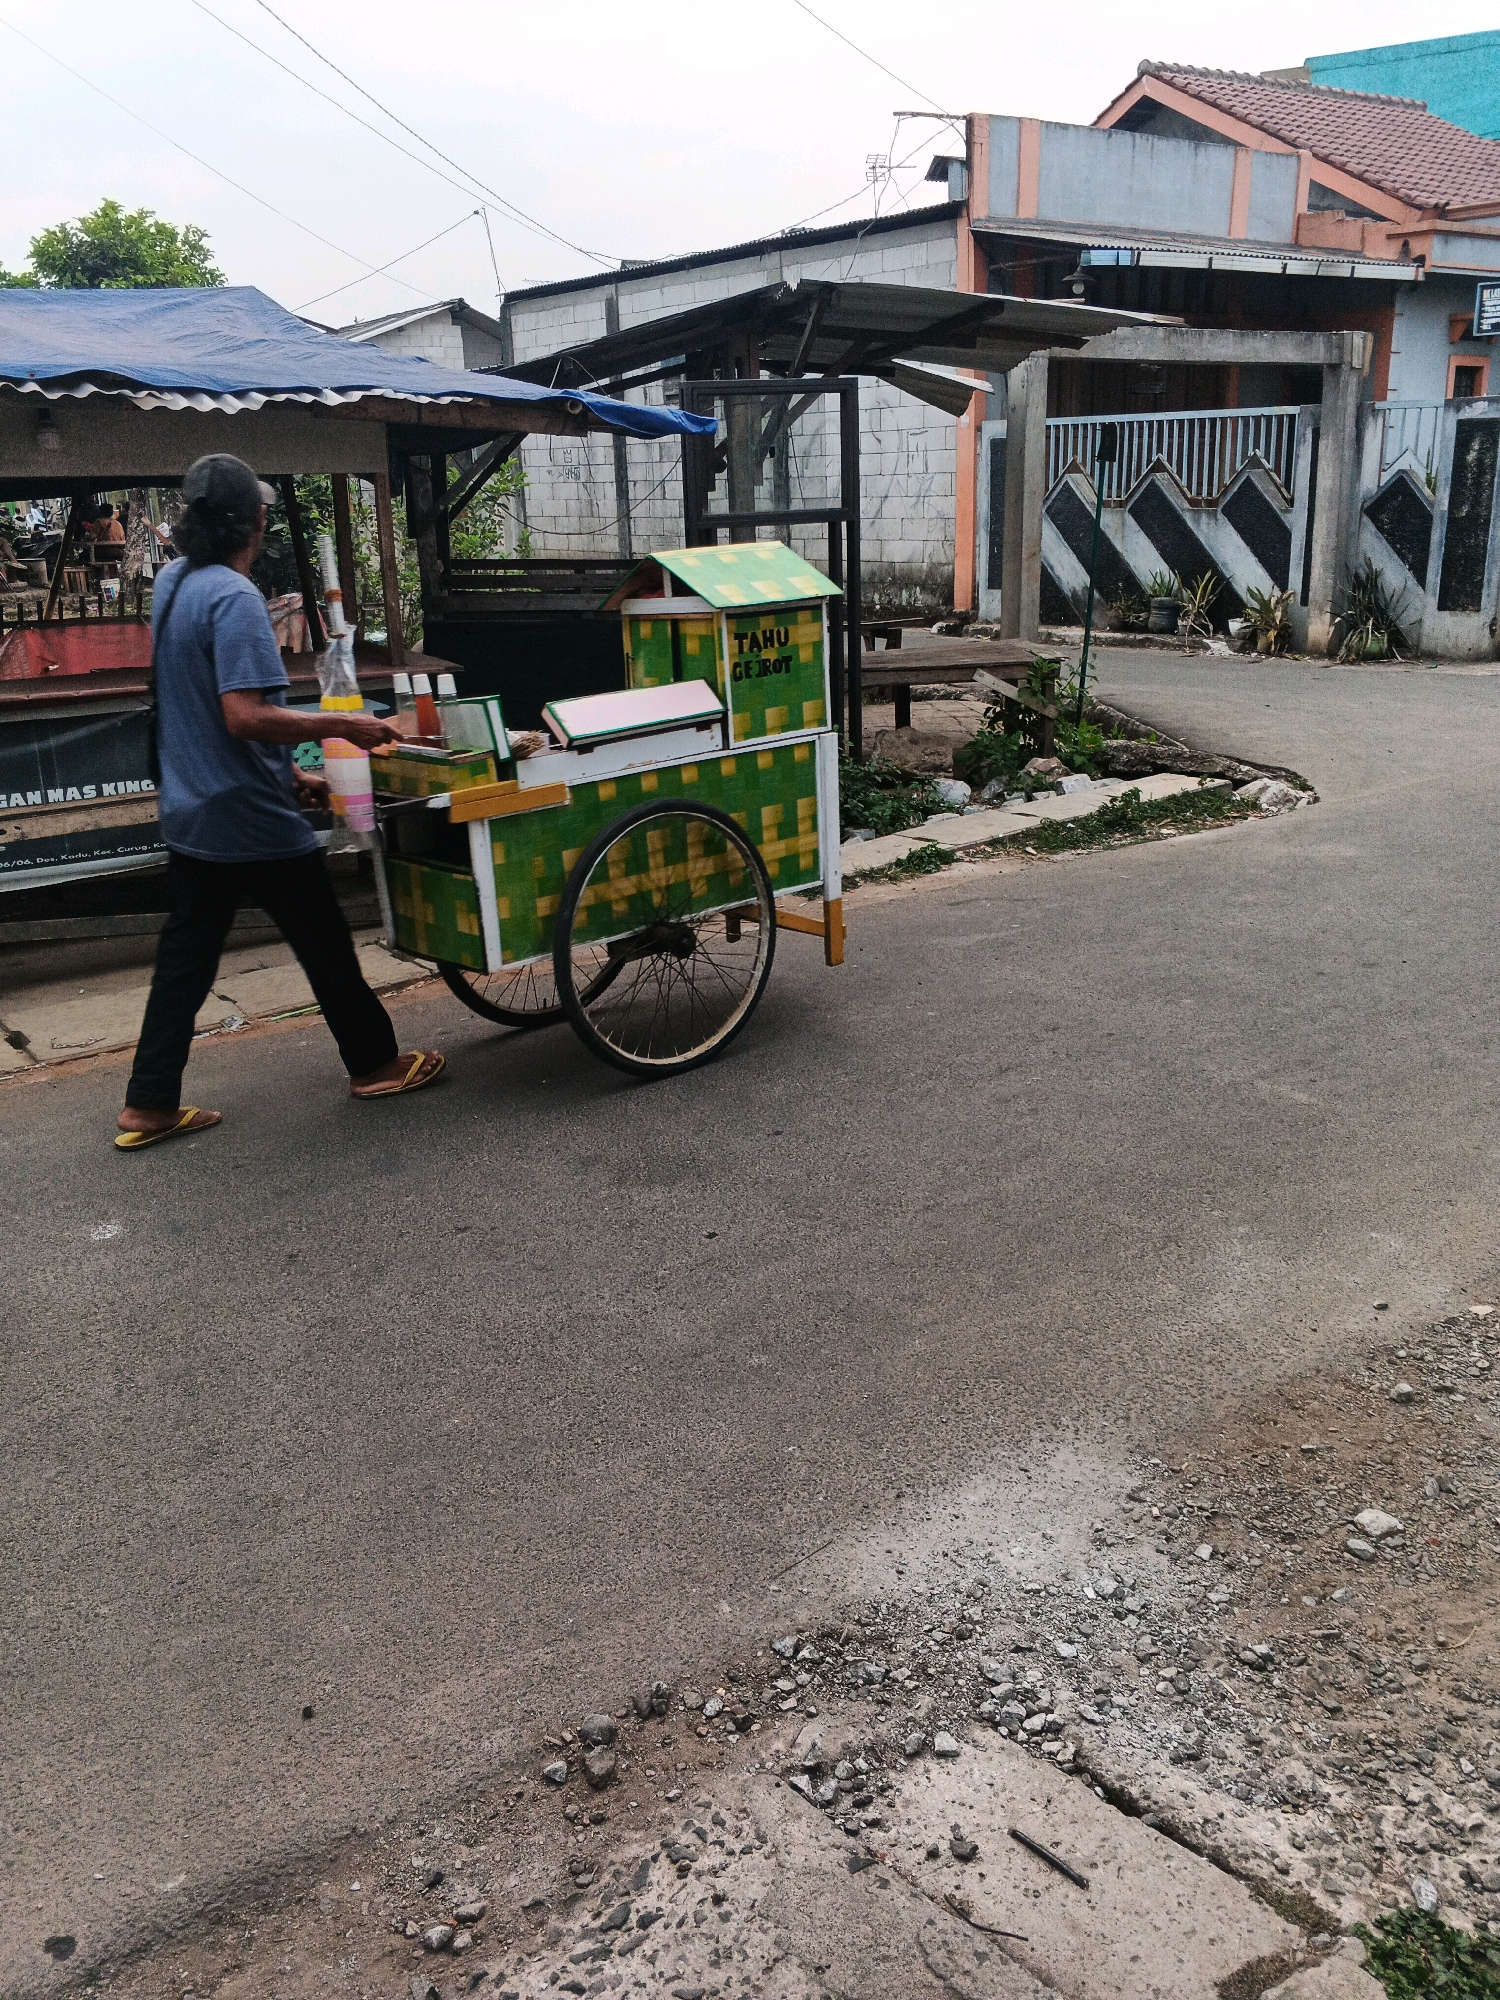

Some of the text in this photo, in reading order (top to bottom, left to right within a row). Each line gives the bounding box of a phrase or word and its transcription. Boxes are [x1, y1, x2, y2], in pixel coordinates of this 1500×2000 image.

[733, 627, 789, 654] TAHU
[47, 785, 97, 803] MAS
[102, 779, 155, 796] KING
